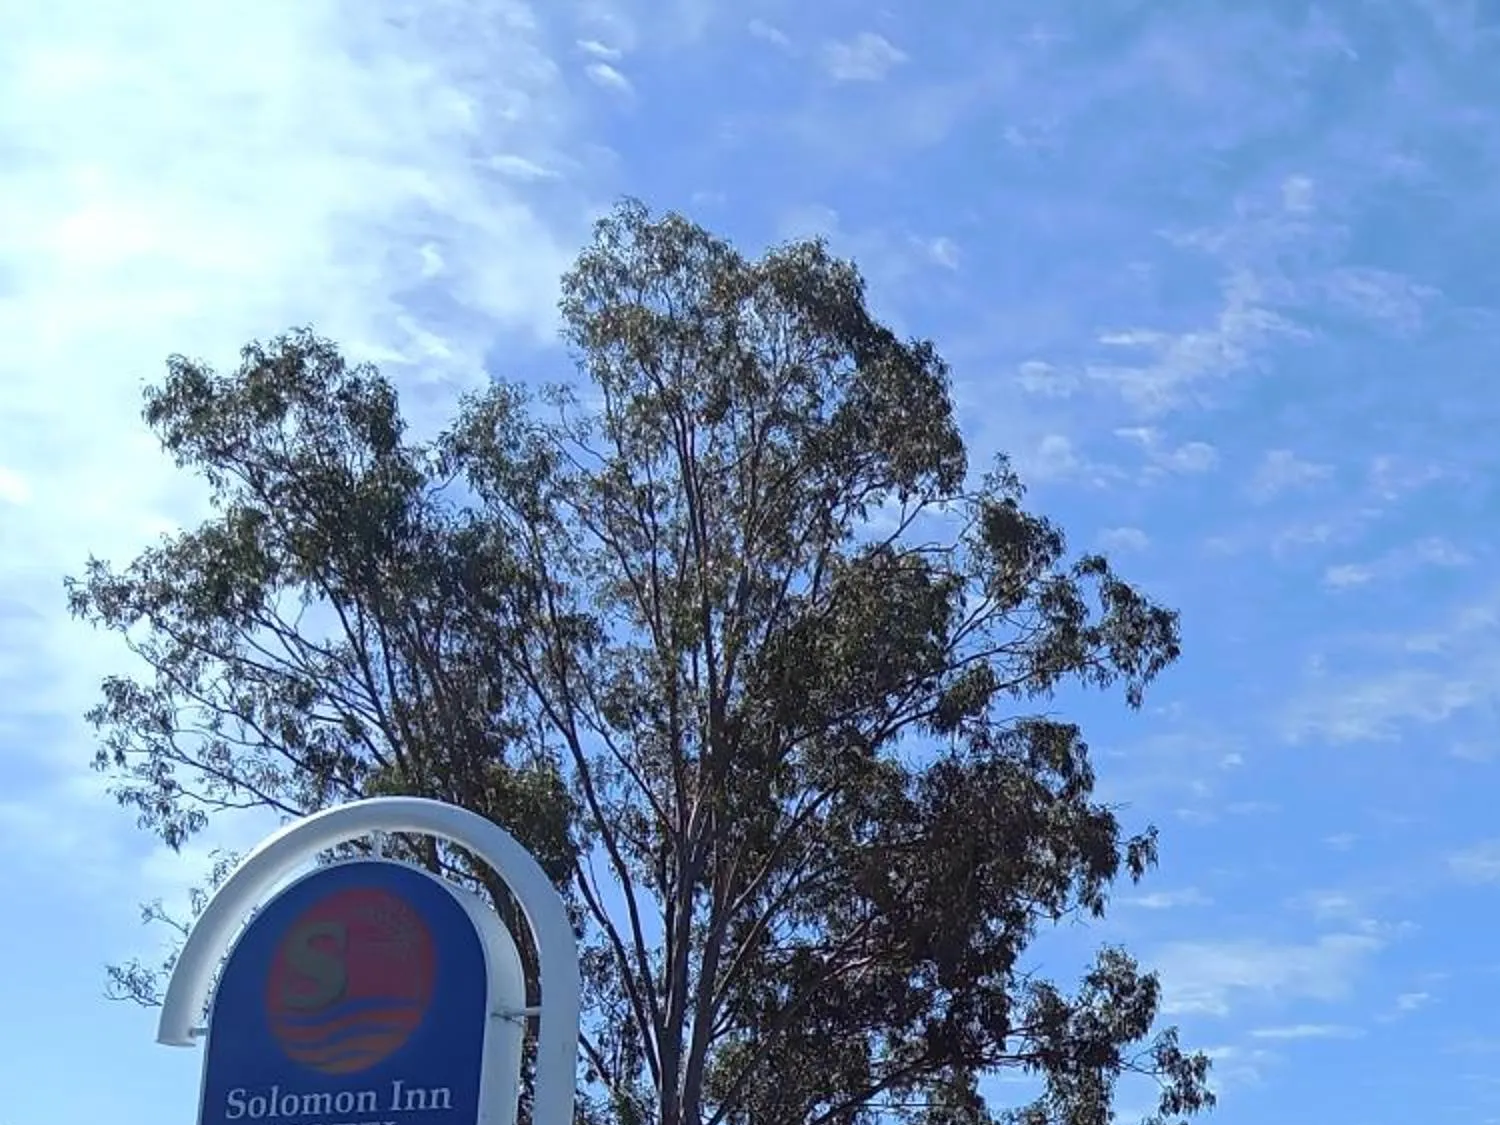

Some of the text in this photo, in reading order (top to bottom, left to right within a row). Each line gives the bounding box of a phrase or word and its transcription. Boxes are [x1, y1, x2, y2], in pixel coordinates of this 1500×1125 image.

[283, 920, 350, 1008] S
[225, 1080, 452, 1119] Solomon Inn
